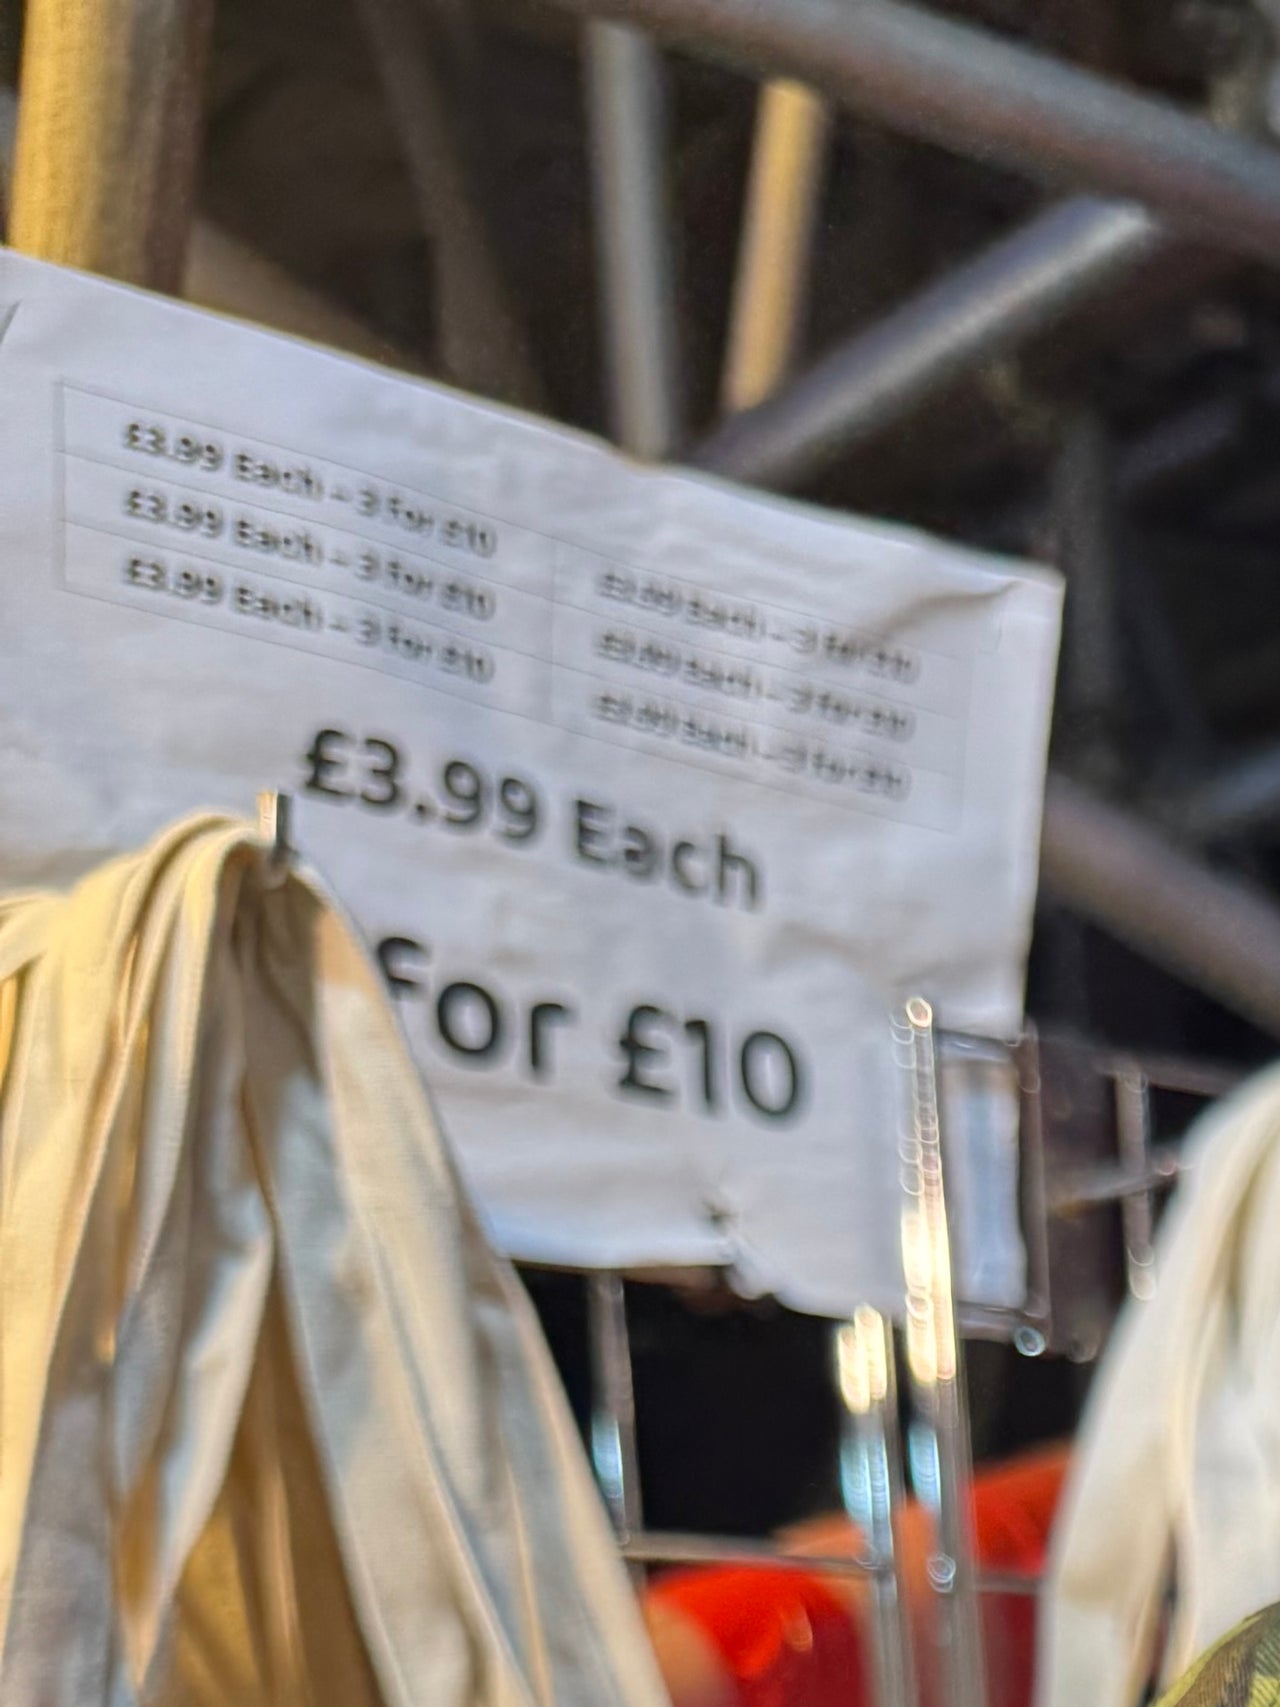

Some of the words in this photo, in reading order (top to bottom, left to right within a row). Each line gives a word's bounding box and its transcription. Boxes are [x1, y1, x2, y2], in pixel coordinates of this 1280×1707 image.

[124, 421, 222, 471] £3.99
[233, 450, 323, 501] Each
[124, 488, 222, 539] £3.99
[233, 517, 323, 567] Each
[124, 556, 222, 605] £3.99
[233, 583, 323, 632] Each
[305, 729, 540, 842] £3.99
[573, 800, 766, 912] Each
[618, 1004, 803, 1117] £10
